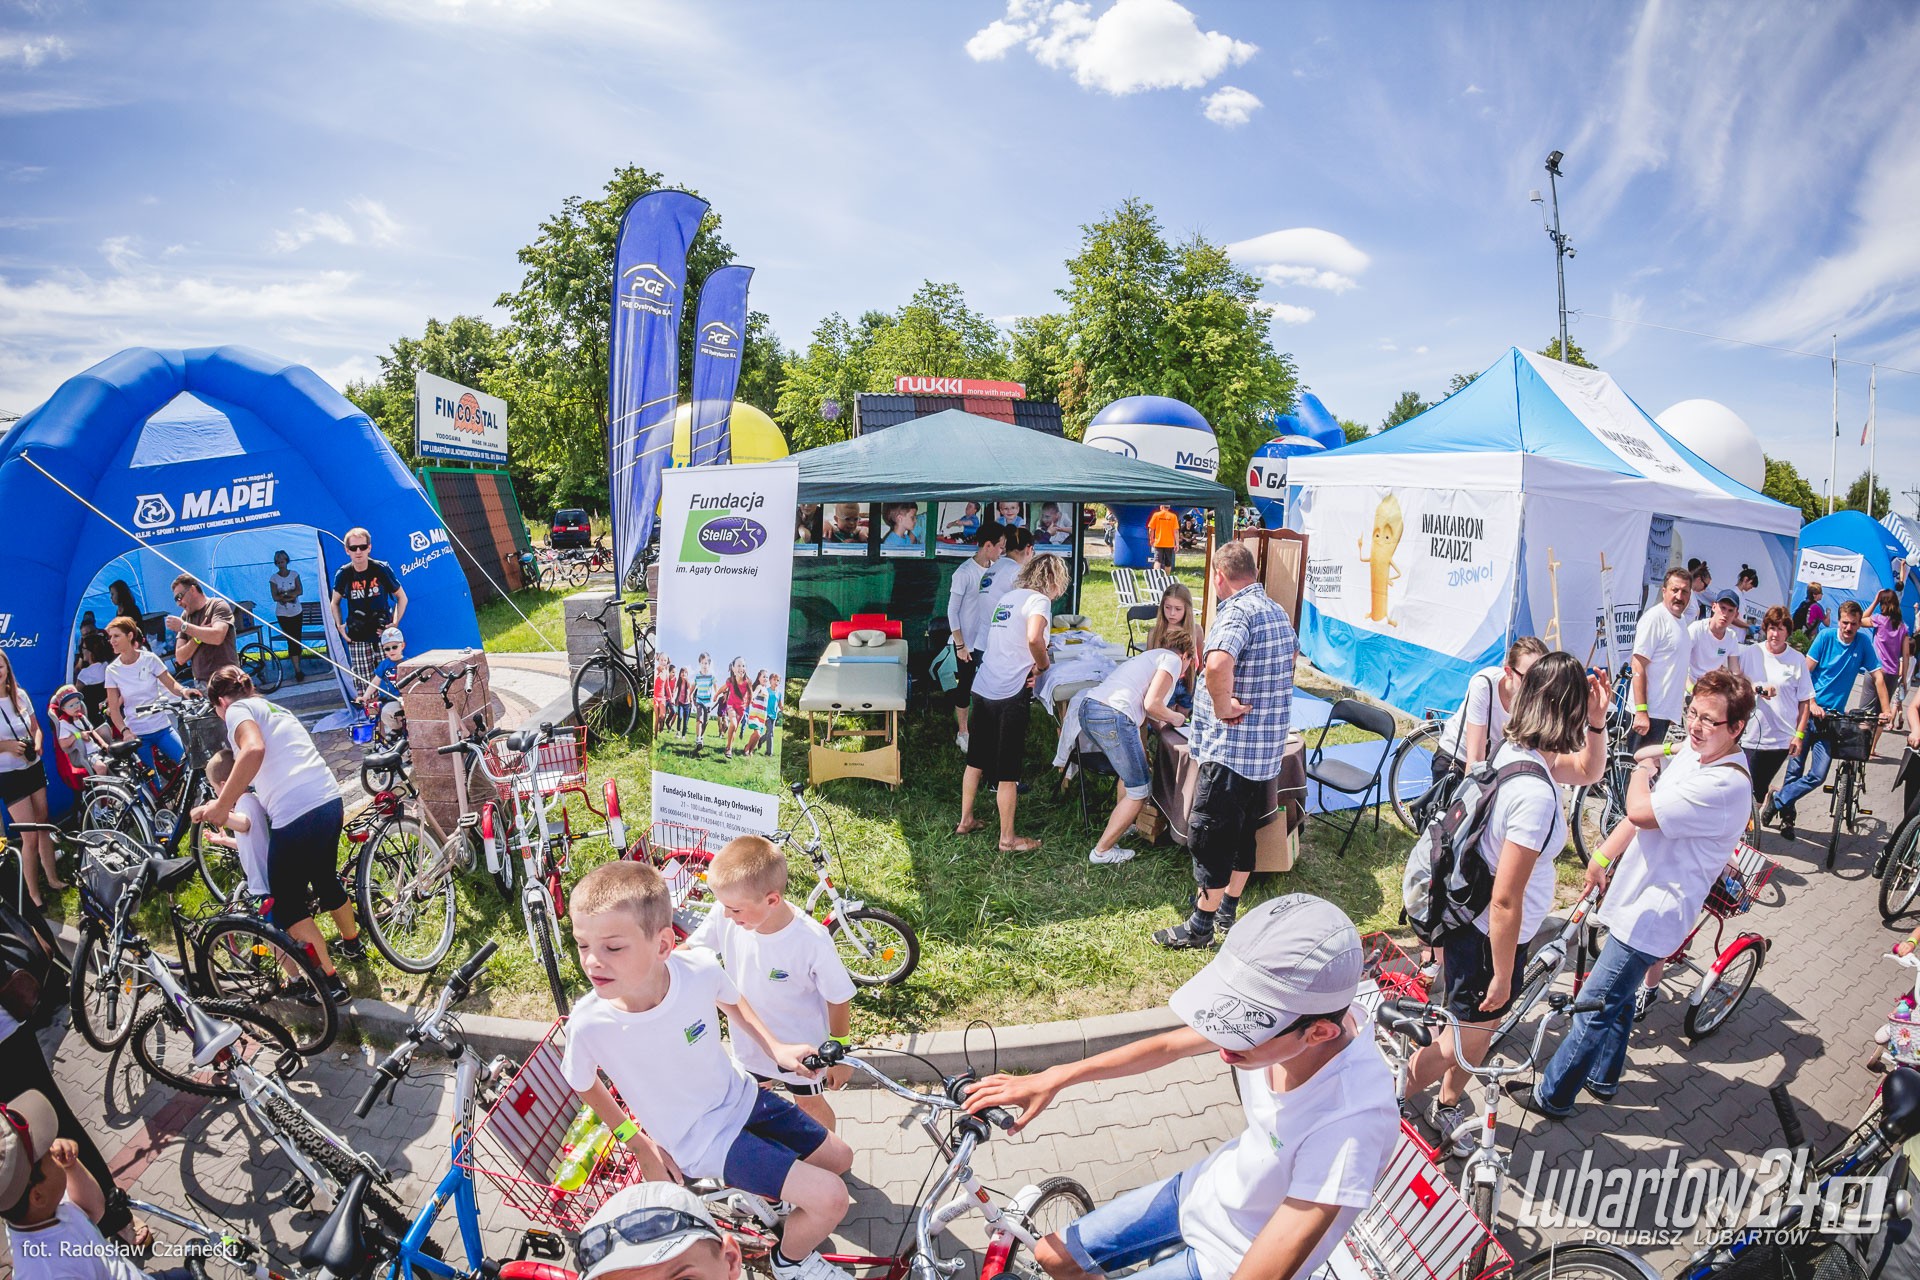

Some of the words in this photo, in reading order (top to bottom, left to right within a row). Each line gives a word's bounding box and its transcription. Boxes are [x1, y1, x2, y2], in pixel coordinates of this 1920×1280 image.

[632, 276, 664, 296] PGE
[621, 300, 632, 308] PGE
[708, 331, 730, 345] PGE
[984, 387, 998, 396] with
[999, 388, 1020, 397] metals
[233, 472, 273, 484] www.mapei.pl
[181, 480, 275, 520] MAPEI
[690, 492, 764, 512] Fundacja
[180, 522, 206, 532] PRODUKTY
[206, 518, 234, 528] CHEMICZNE
[1422, 513, 1483, 540] MAKARON
[702, 529, 733, 541] Stella
[1430, 537, 1472, 563] RZĄDZI
[400, 549, 441, 576] Budujesz
[676, 565, 688, 573] im.
[690, 565, 712, 576] Agaty
[714, 565, 758, 577] Orłowskiej
[1809, 561, 1856, 573] GASPOL
[1447, 560, 1493, 586] ZDROWO!
[663, 785, 686, 799] Fundacja
[687, 790, 703, 801] Stella
[704, 794, 713, 803] im.
[714, 796, 731, 808] Agaty
[731, 801, 763, 817] Orłowskiej
[1217, 1000, 1235, 1013] SPORT
[461, 1098, 472, 1180] KROSS
